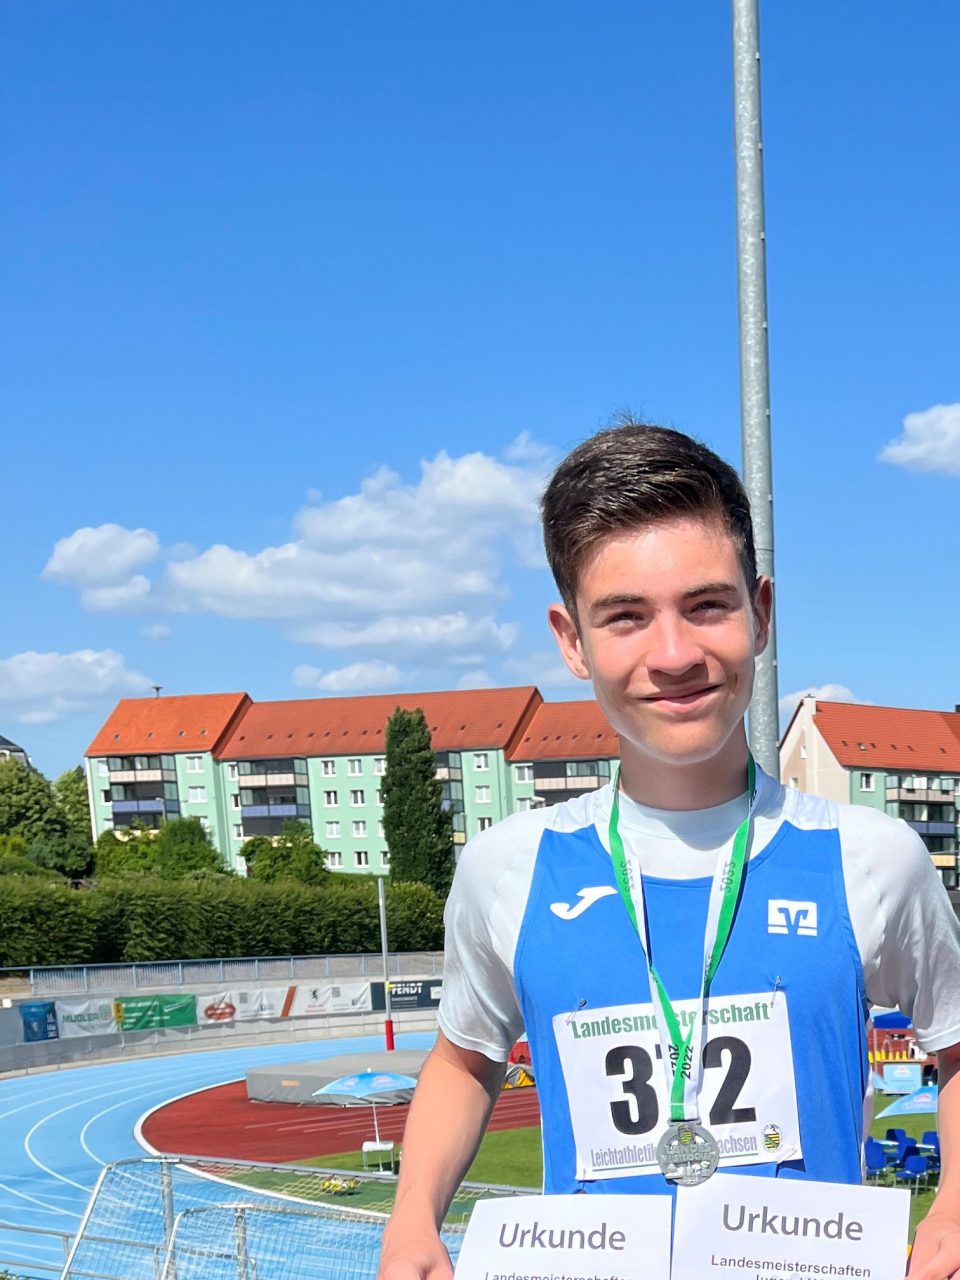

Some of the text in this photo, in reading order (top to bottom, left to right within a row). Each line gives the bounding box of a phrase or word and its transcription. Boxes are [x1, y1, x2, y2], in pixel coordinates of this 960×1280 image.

[680, 1045, 694, 1080] 2022
[605, 1036, 757, 1136] 32
[717, 1135, 758, 1155] achsen
[499, 1221, 626, 1250] Urkunde
[723, 1204, 864, 1241] Urkunde
[711, 1254, 871, 1277] Landesmeisterschaften
